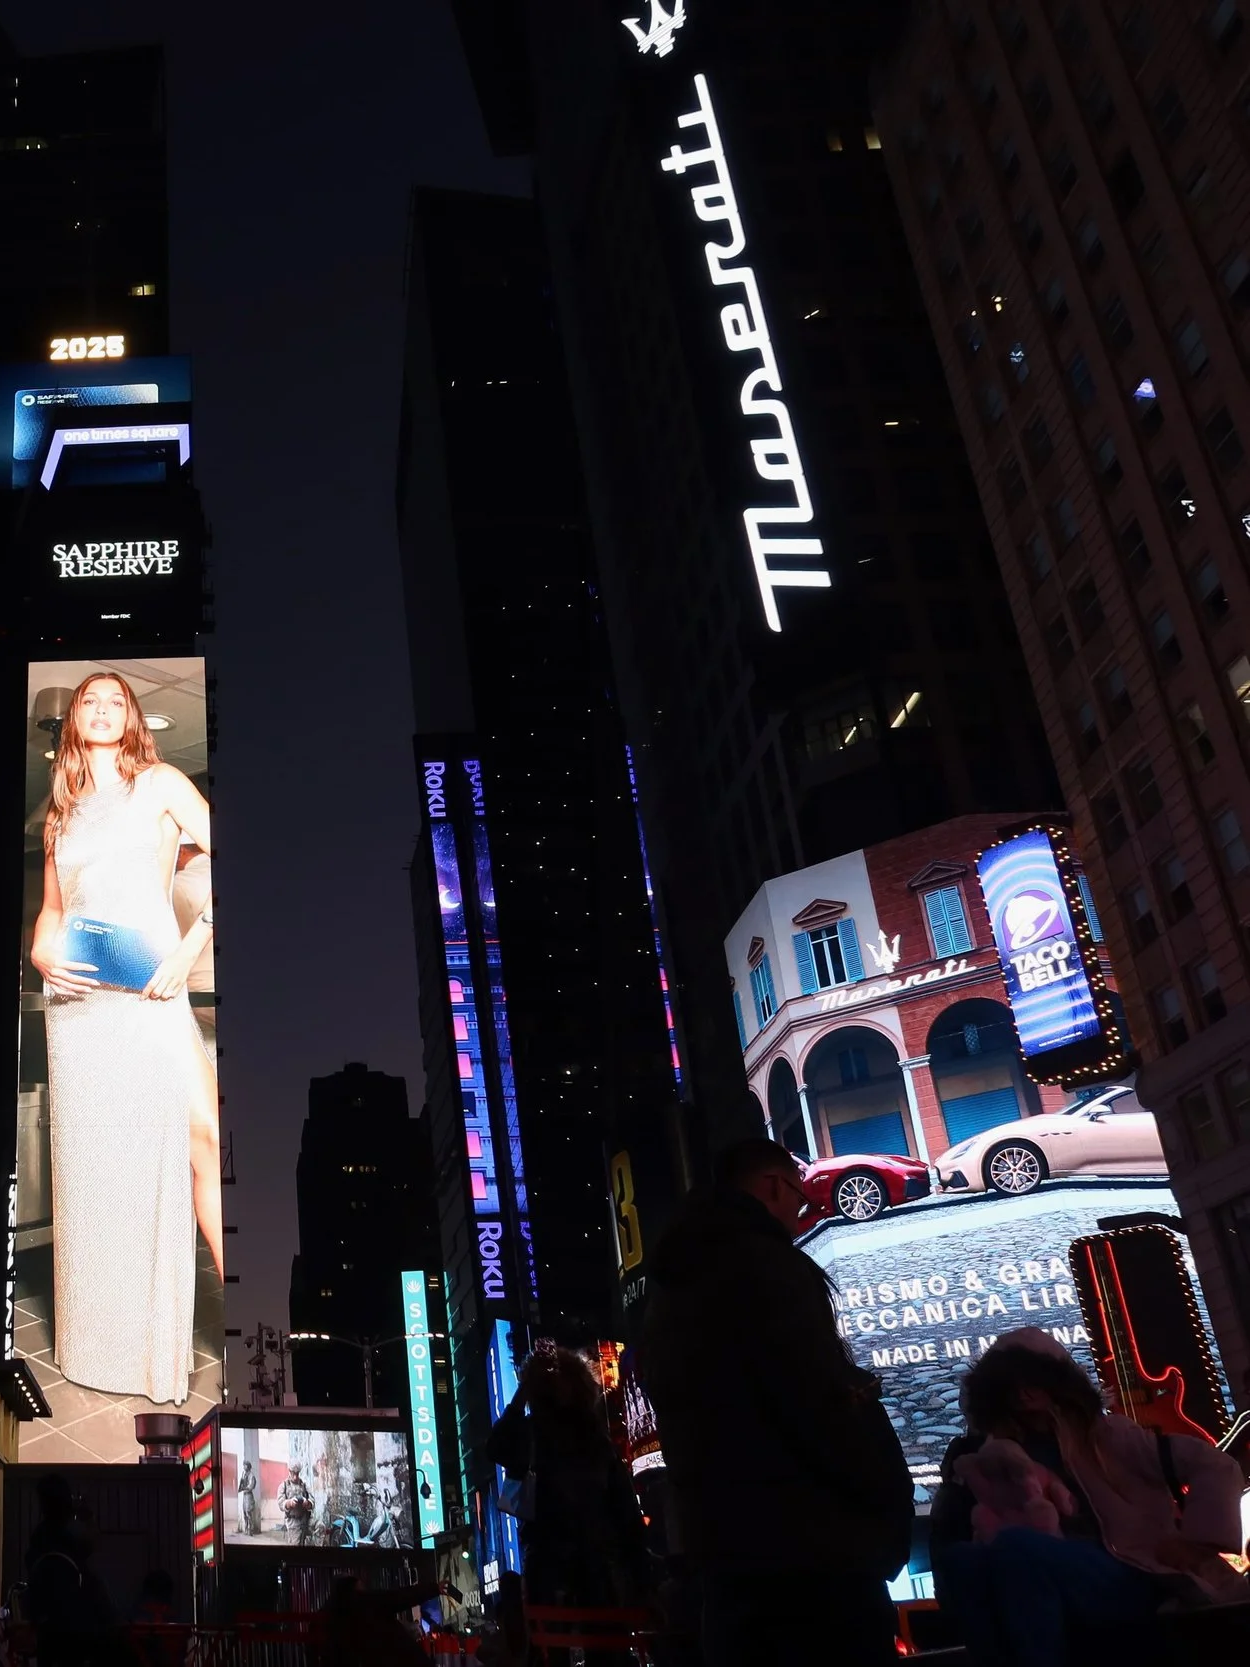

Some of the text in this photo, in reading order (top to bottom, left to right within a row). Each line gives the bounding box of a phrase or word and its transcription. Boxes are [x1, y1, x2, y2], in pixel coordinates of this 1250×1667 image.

[50, 335, 125, 360] 2025
[660, 73, 832, 633] Maserati
[64, 426, 179, 442] one times square
[52, 540, 179, 561] SAPPHIRE
[59, 557, 173, 578] RESERVE
[423, 761, 447, 818] ROKU
[1010, 941, 1071, 975] TACO
[815, 958, 978, 1012] Maserati
[1019, 958, 1076, 993] BELL
[611, 1150, 643, 1271] 3
[476, 1221, 506, 1300] ROKU
[963, 1269, 984, 1292] &
[999, 1256, 1071, 1285] GRA
[626, 1276, 646, 1304] 24/7
[871, 1342, 939, 1368] MADE
[945, 1338, 971, 1359] IN
